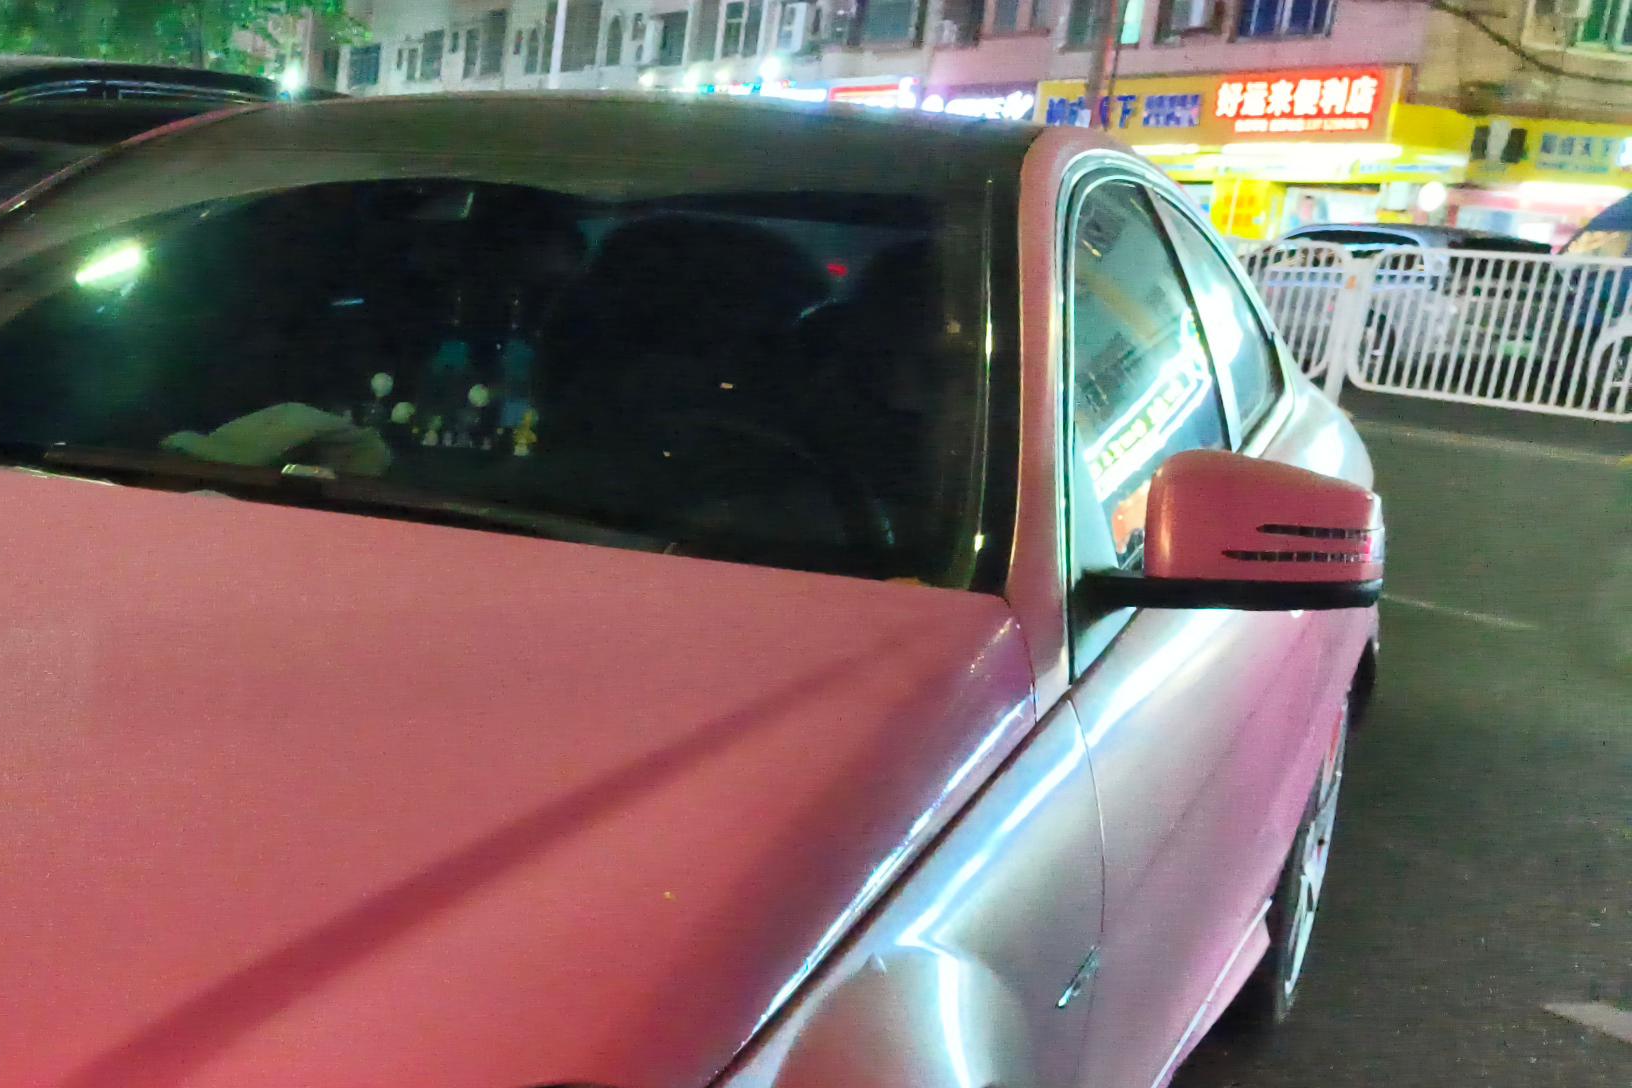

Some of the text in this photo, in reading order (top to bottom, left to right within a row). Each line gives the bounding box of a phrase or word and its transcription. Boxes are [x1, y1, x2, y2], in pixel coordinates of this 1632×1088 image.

[1216, 76, 1378, 117] 好运来便利店
